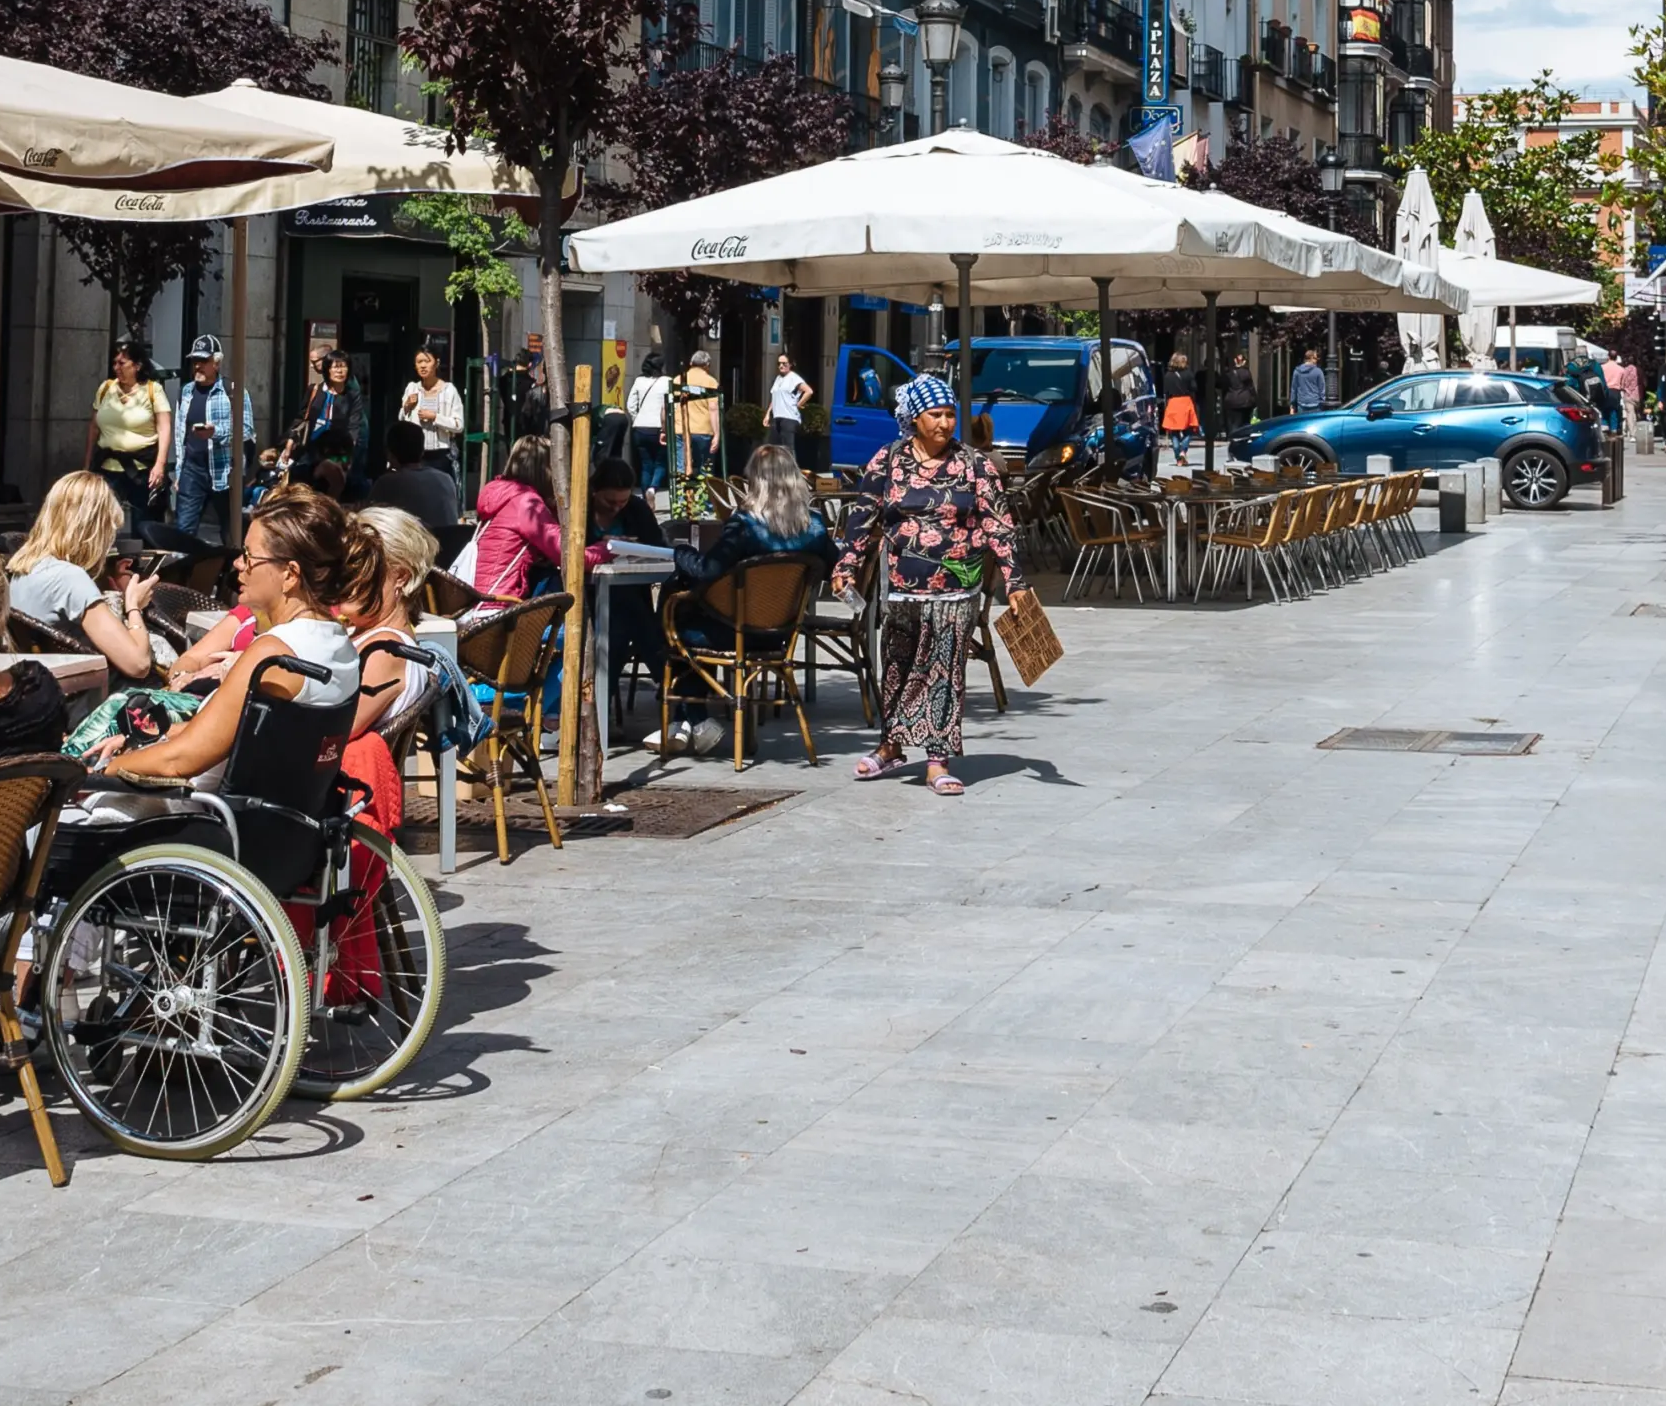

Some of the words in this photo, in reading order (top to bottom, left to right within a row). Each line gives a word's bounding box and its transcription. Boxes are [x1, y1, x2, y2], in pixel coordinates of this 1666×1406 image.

[1149, 29, 1163, 96] PLAZA
[115, 194, 167, 212] Coca-Cola
[294, 209, 377, 227] Restaurante
[691, 235, 749, 261] Coca-Cola
